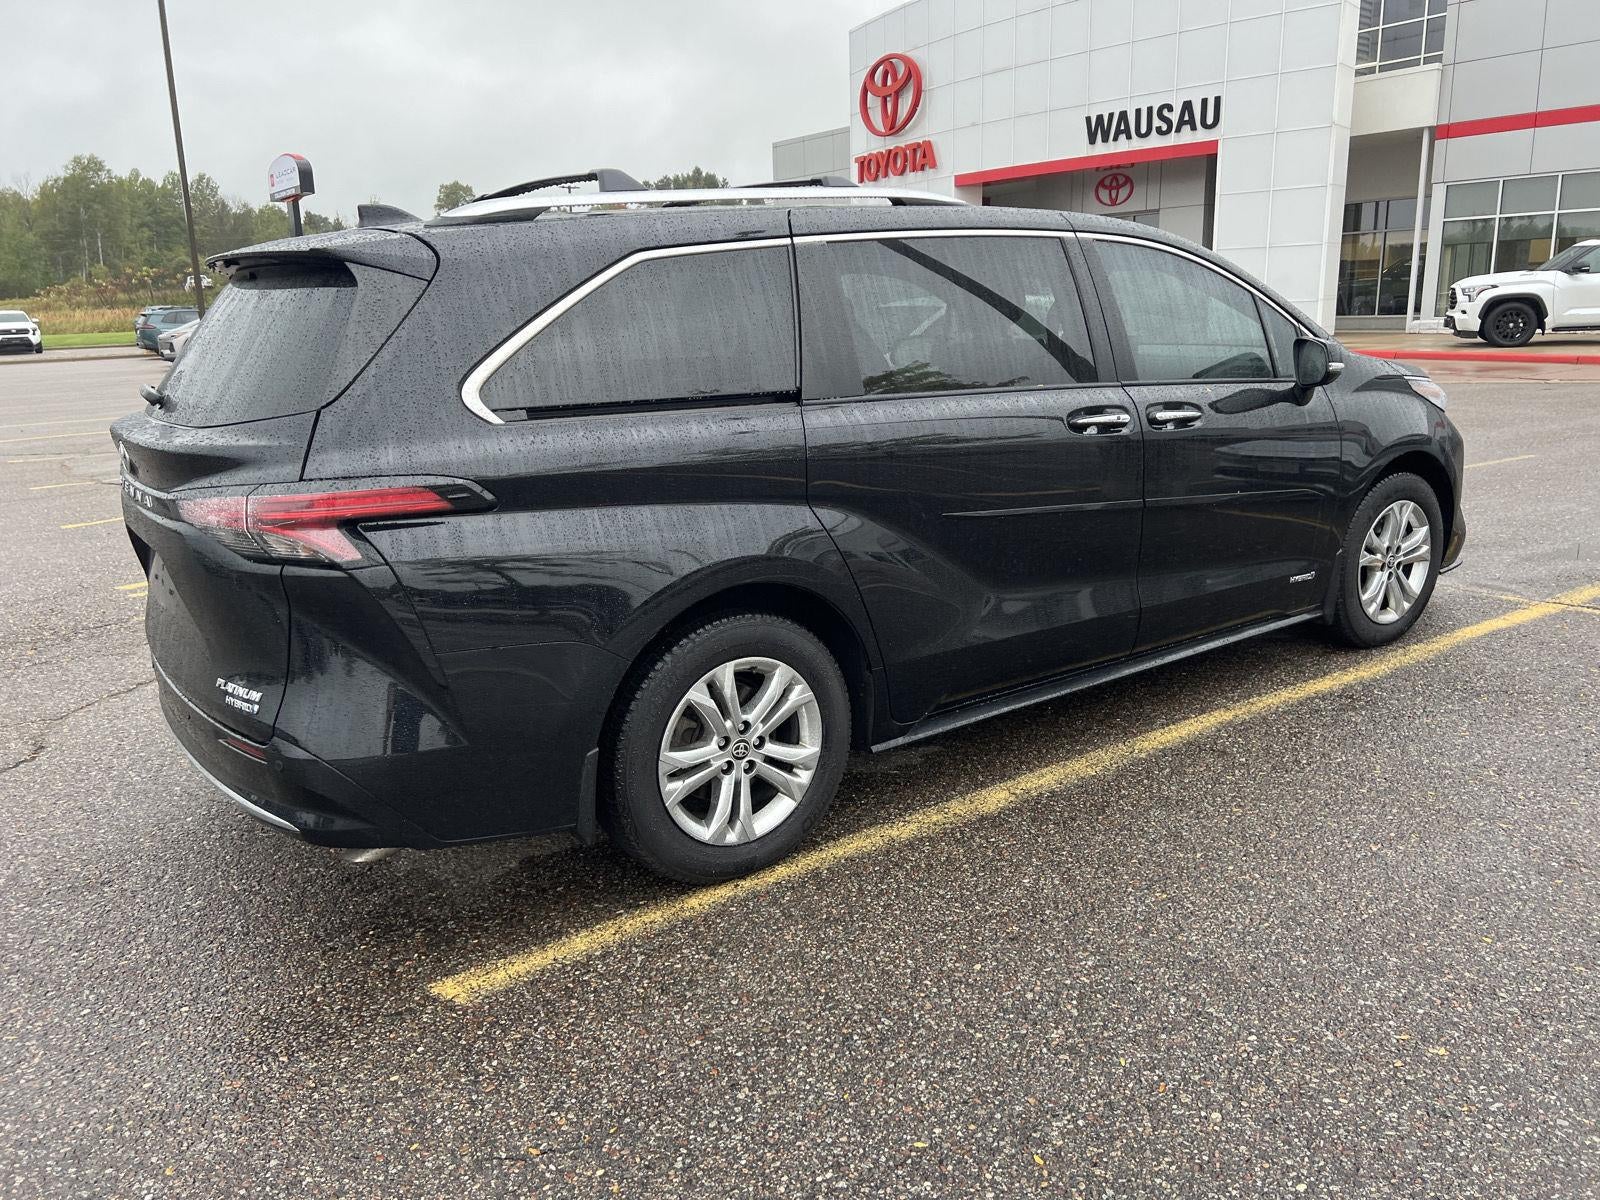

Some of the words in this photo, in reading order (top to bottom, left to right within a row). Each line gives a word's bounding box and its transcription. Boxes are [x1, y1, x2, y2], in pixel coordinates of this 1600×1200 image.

[1085, 95, 1221, 145] WAUSAU
[855, 140, 937, 184] TOYOTA
[215, 677, 263, 702] PLATINUM
[225, 695, 253, 713] HYBRID
